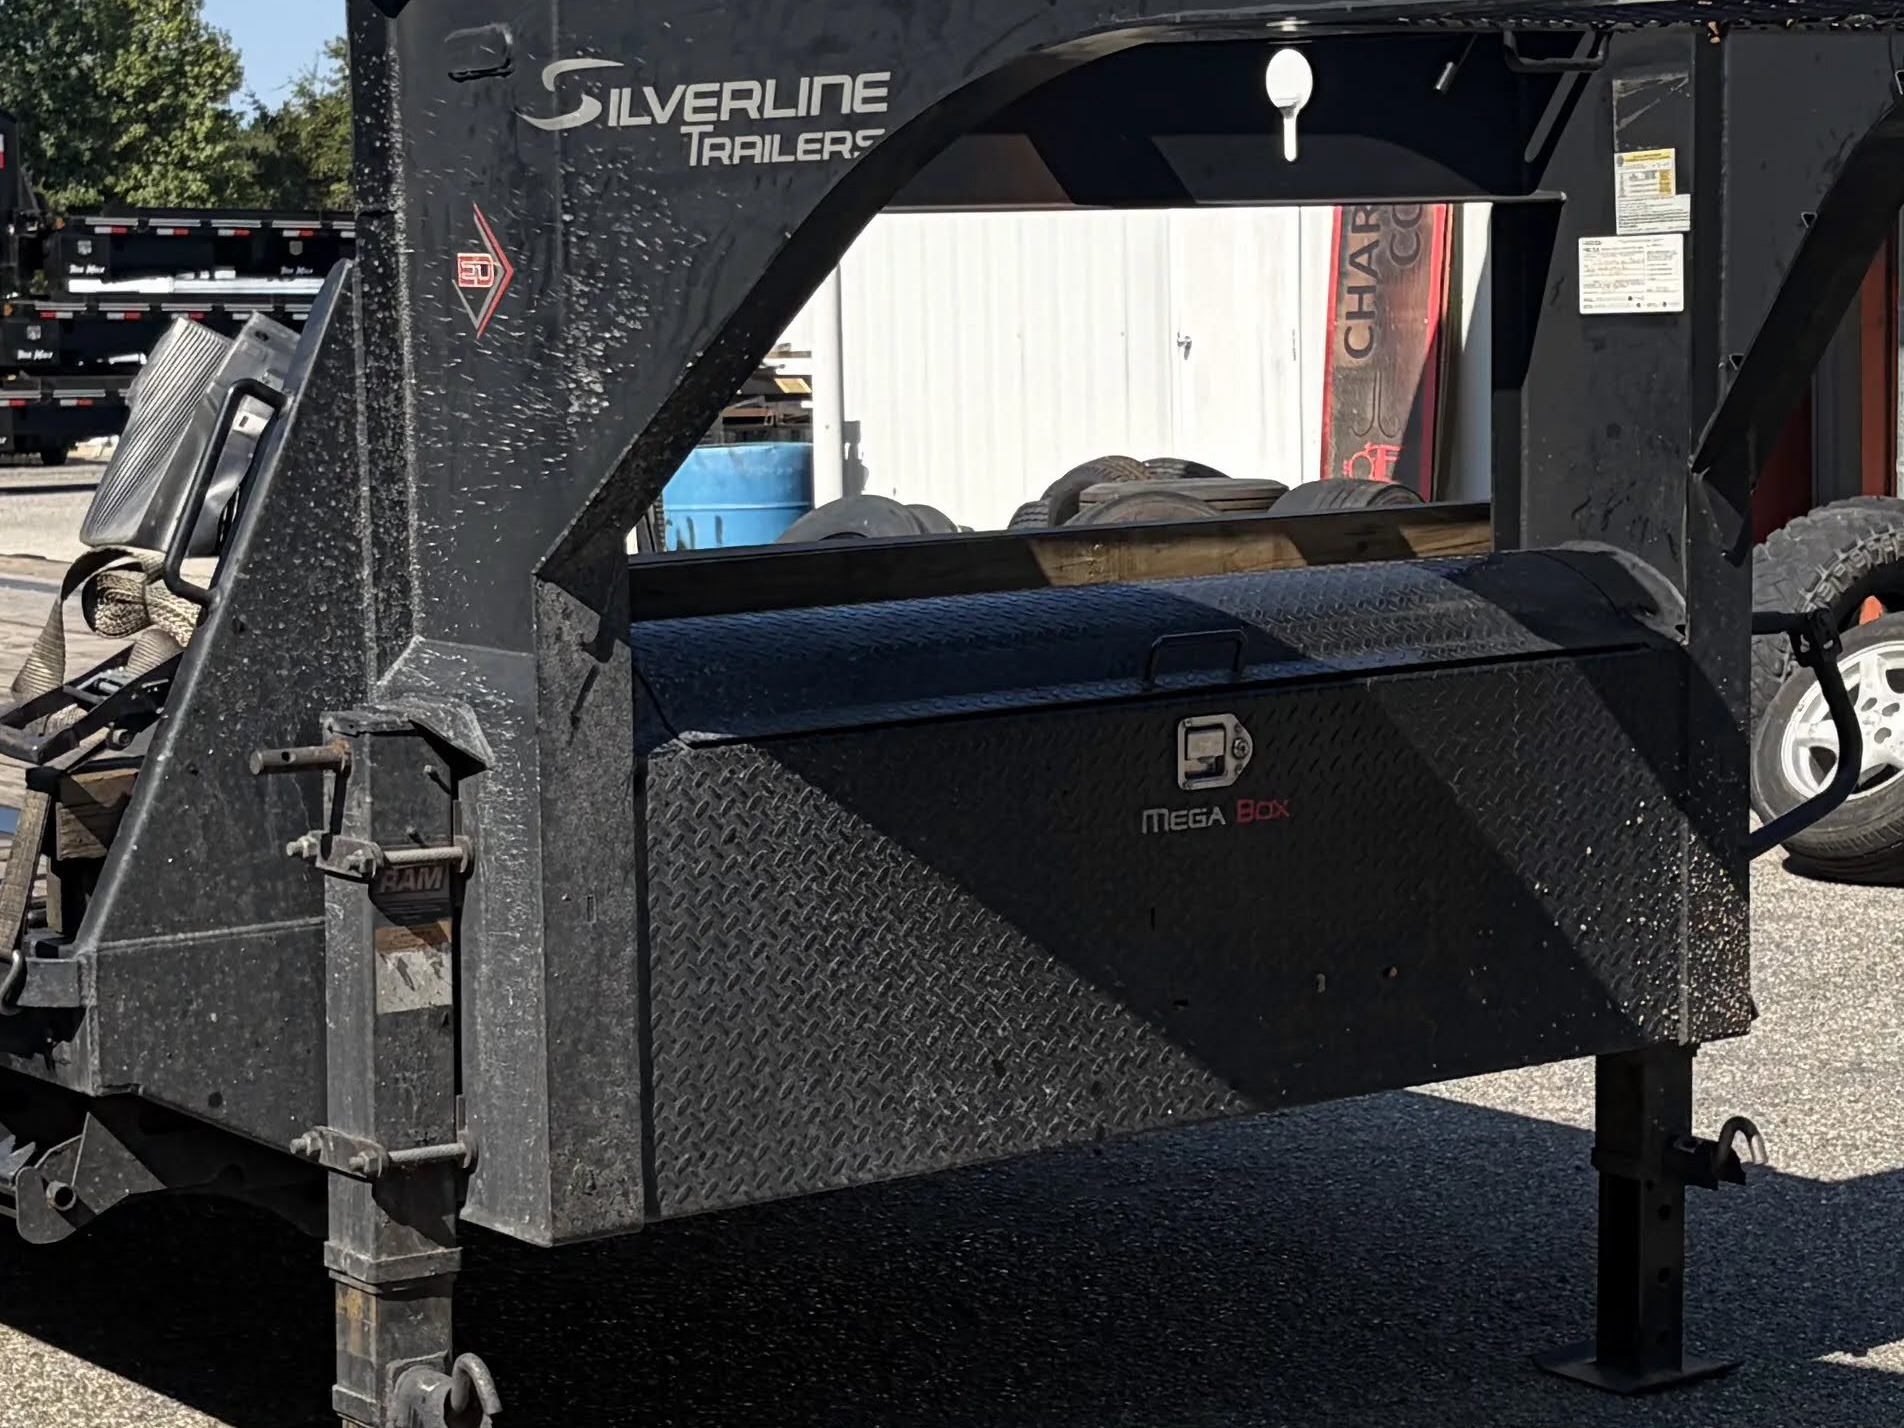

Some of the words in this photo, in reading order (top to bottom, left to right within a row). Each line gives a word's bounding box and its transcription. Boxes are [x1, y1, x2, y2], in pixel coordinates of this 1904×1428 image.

[514, 57, 892, 131] SILVERLINE
[1141, 806, 1227, 834] MEGA
[1236, 798, 1291, 826] BOX
[380, 865, 444, 893] RAM
